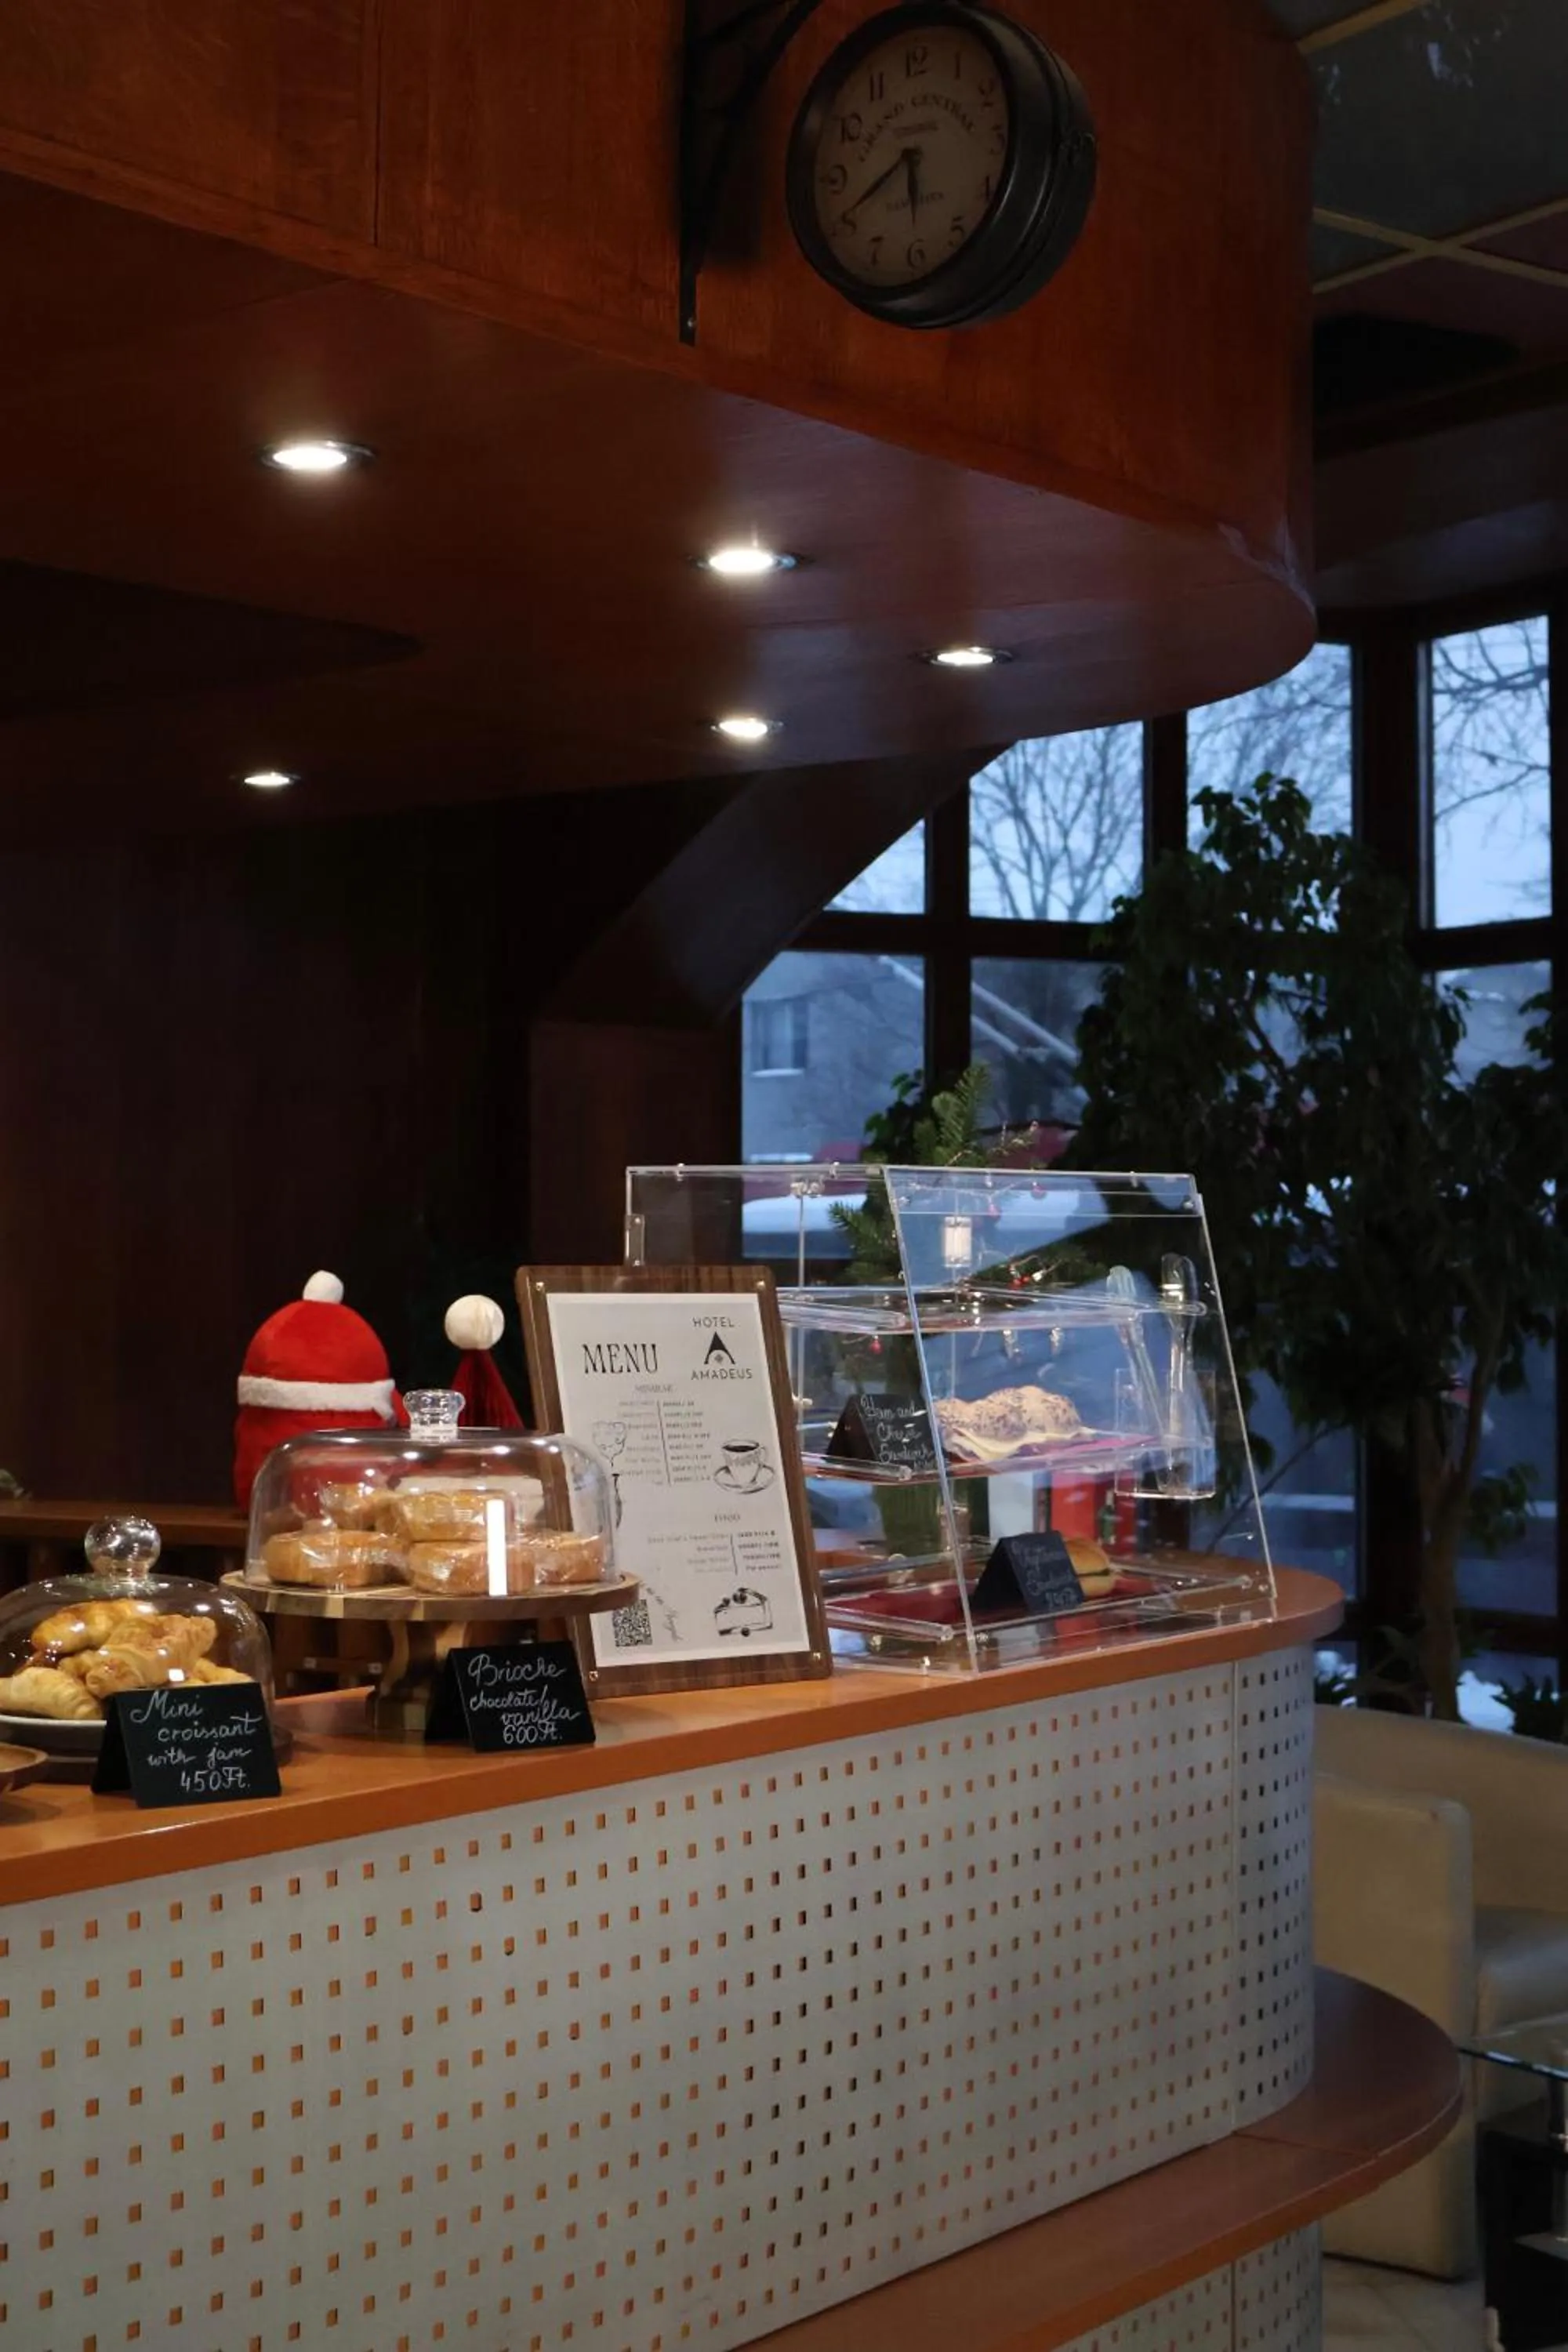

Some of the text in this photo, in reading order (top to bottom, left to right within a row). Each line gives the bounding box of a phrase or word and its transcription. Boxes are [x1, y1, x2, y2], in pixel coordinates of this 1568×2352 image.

[905, 45, 929, 78] 12
[953, 50, 963, 80] 1
[869, 71, 884, 103] 11
[978, 78, 995, 107] 2
[837, 112, 863, 143] 10
[823, 164, 848, 196] 9
[947, 216, 966, 248] 5
[869, 235, 884, 267] 7
[906, 238, 926, 269] 6
[691, 1316, 735, 1328] HOTEL
[582, 1342, 659, 1374] MENU
[691, 1367, 753, 1380] AMADEUS
[468, 1653, 567, 1686] Brioche
[129, 1690, 204, 1723] Mini
[501, 1699, 582, 1726] vanilla
[158, 1711, 263, 1742] croissant
[147, 1742, 252, 1769] with jam
